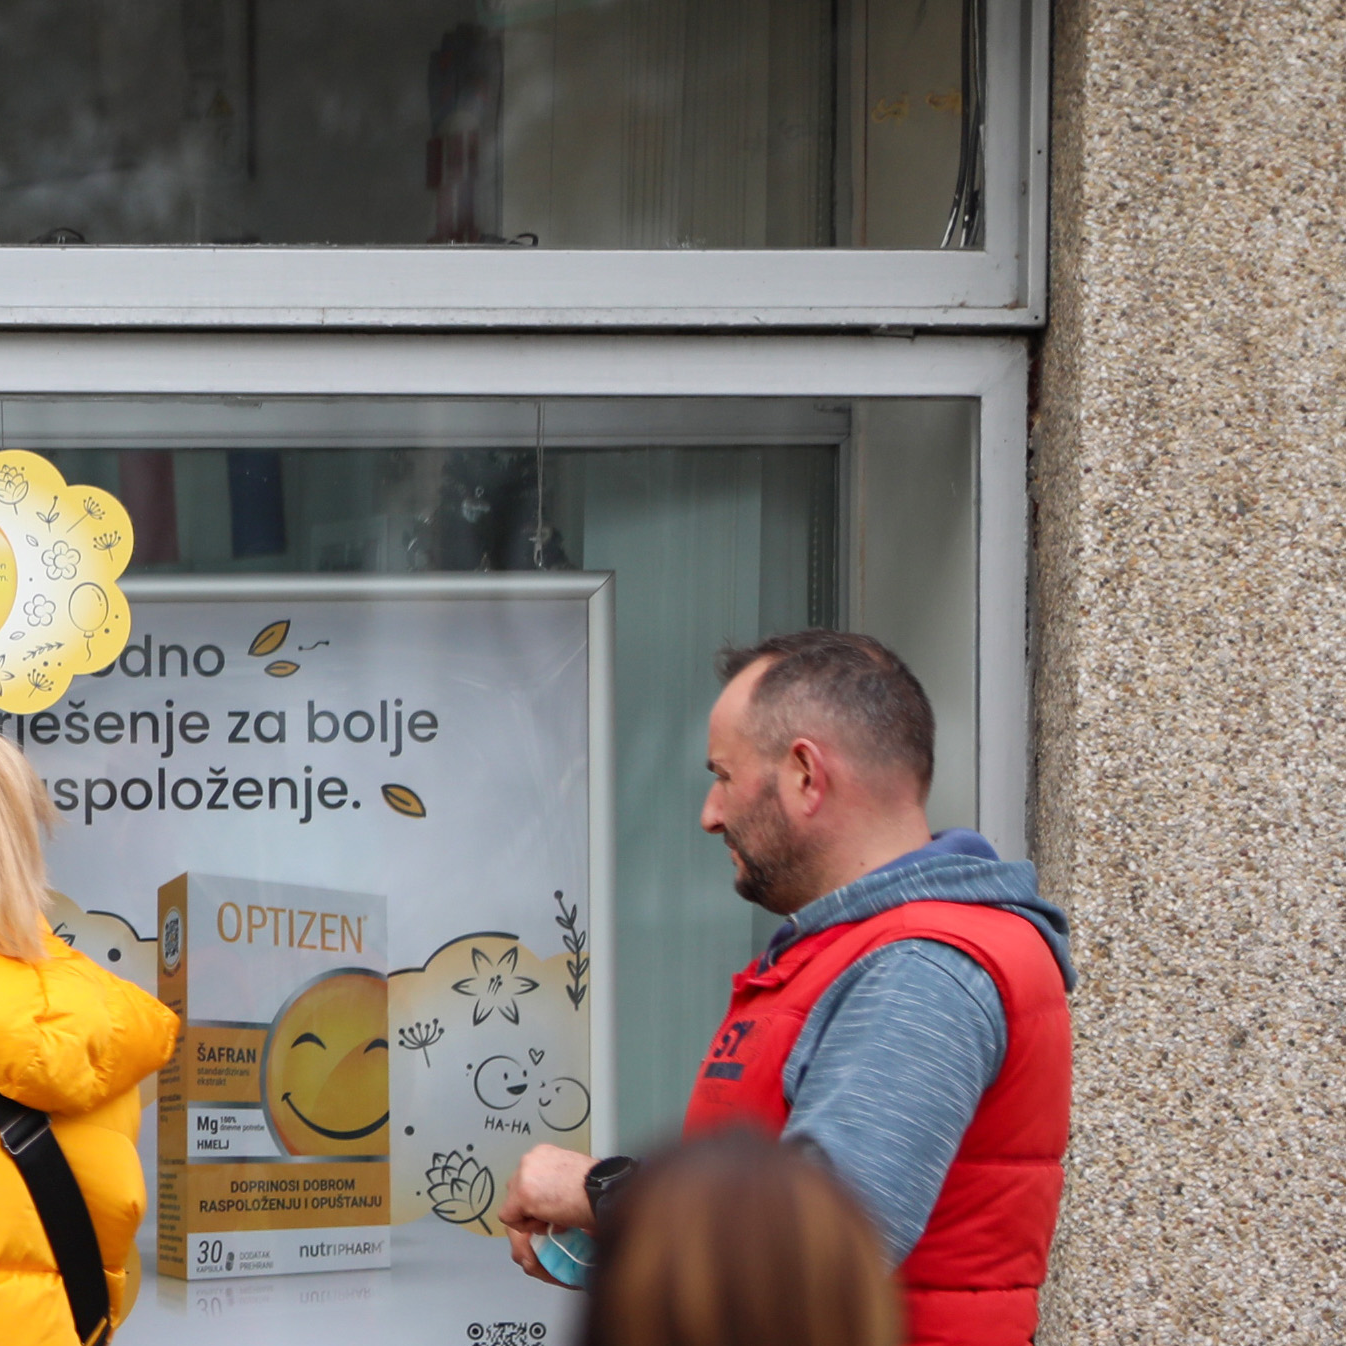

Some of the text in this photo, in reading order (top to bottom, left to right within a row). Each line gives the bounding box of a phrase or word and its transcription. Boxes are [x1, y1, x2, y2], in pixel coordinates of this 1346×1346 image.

[228, 710, 286, 744] za
[307, 699, 438, 757] bolje
[217, 901, 364, 954] OPTIZEN
[197, 1043, 256, 1063] ŠAFRAN
[197, 1116, 218, 1134] Mg
[484, 1115, 531, 1136] HA-HA
[197, 1139, 229, 1149] HMELJ
[231, 1179, 355, 1193] DOPRINOSI DOBROM
[200, 1194, 382, 1213] RASPOLOŽENJU I OPUŠTANJU
[197, 1240, 223, 1264] 30
[240, 1252, 270, 1260] DODATAK
